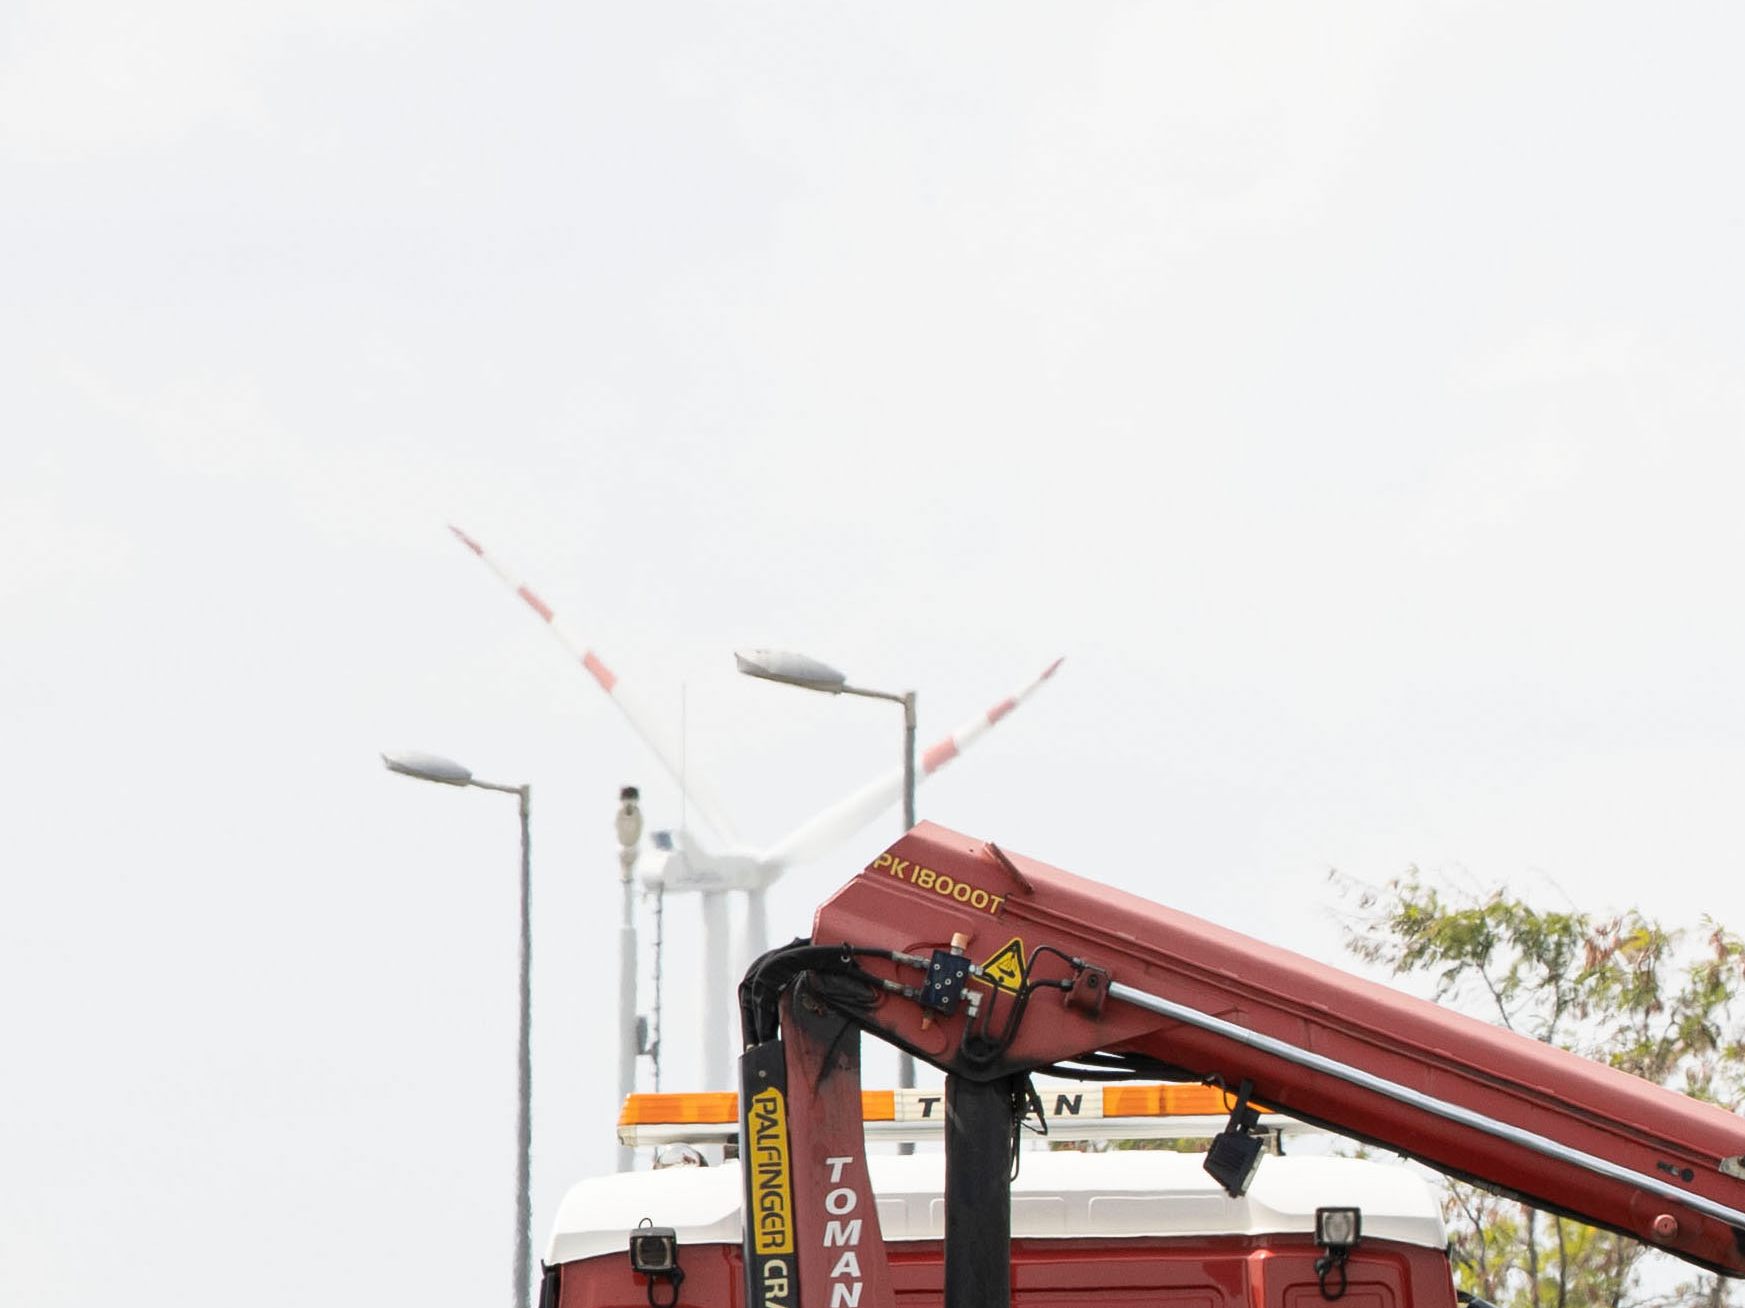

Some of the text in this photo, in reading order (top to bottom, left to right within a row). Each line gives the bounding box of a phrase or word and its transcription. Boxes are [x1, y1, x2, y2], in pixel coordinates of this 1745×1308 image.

[872, 853, 1005, 914] PK 18000T
[754, 1095, 785, 1249] PALFINGER
[823, 1156, 863, 1308] TOMAN
